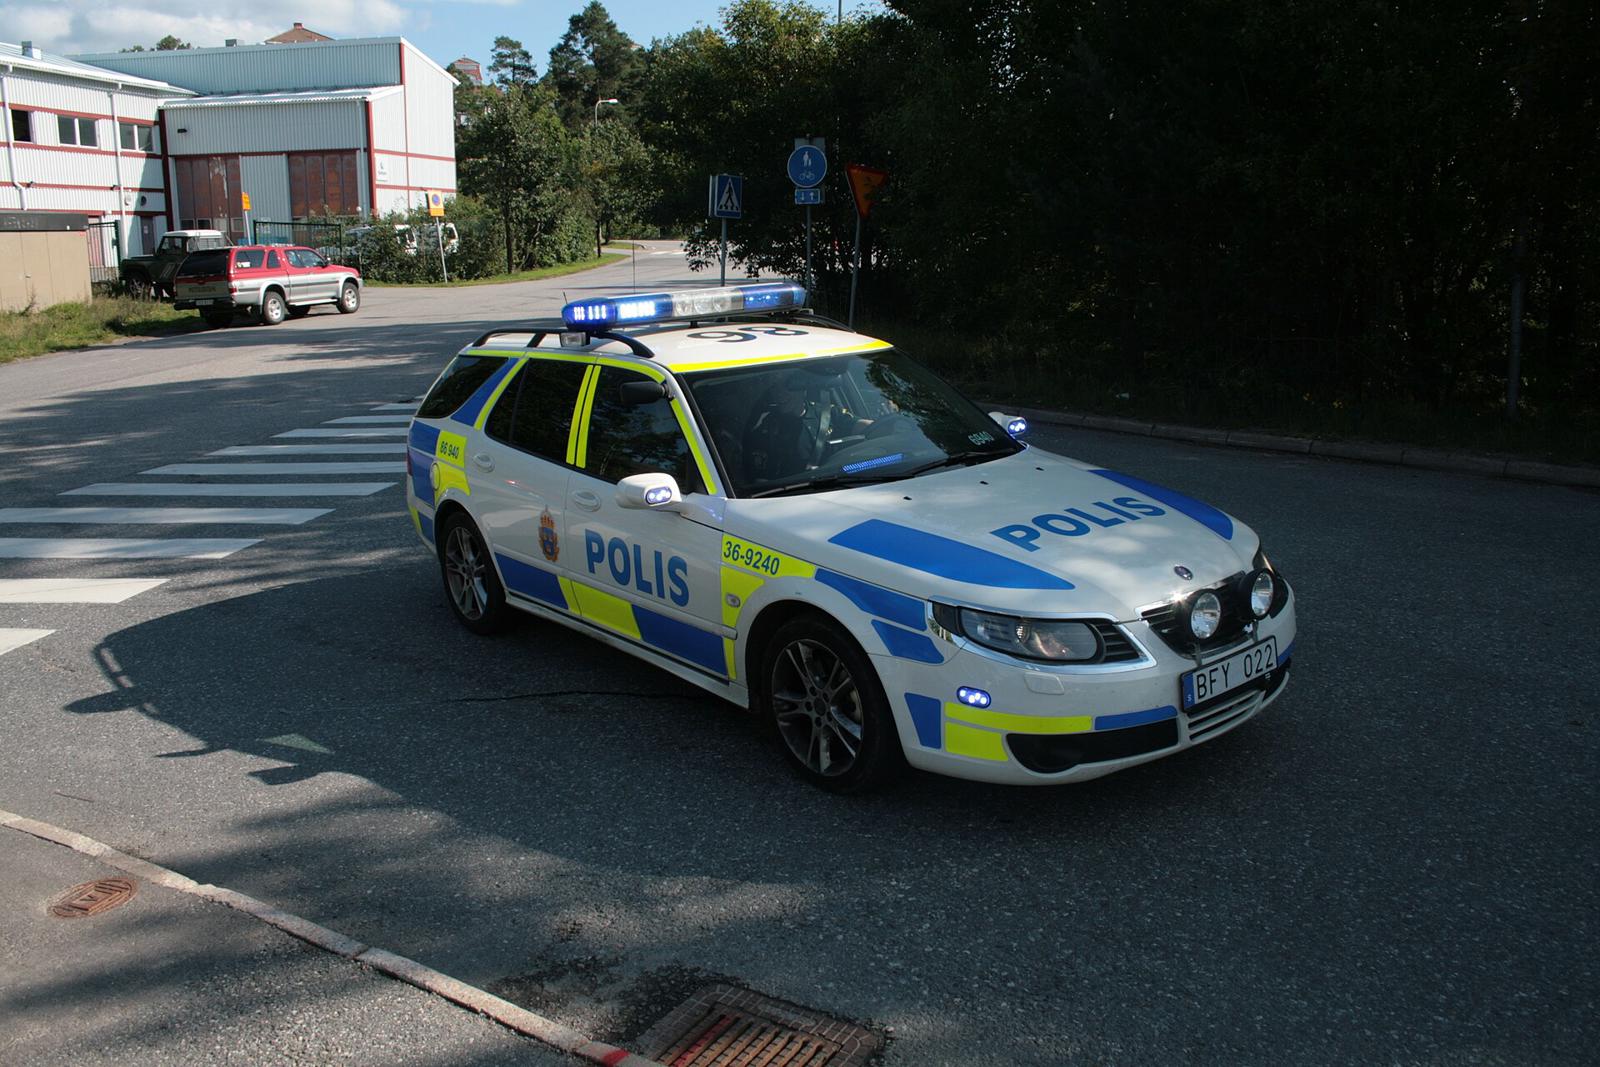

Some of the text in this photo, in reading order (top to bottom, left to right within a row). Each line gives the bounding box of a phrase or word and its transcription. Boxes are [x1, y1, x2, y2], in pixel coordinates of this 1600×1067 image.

[448, 445, 459, 459] 940
[988, 496, 1167, 552] POLIS
[585, 528, 690, 607] POLIS
[723, 541, 780, 576] 36-9240
[1196, 644, 1274, 700] BFY 022
